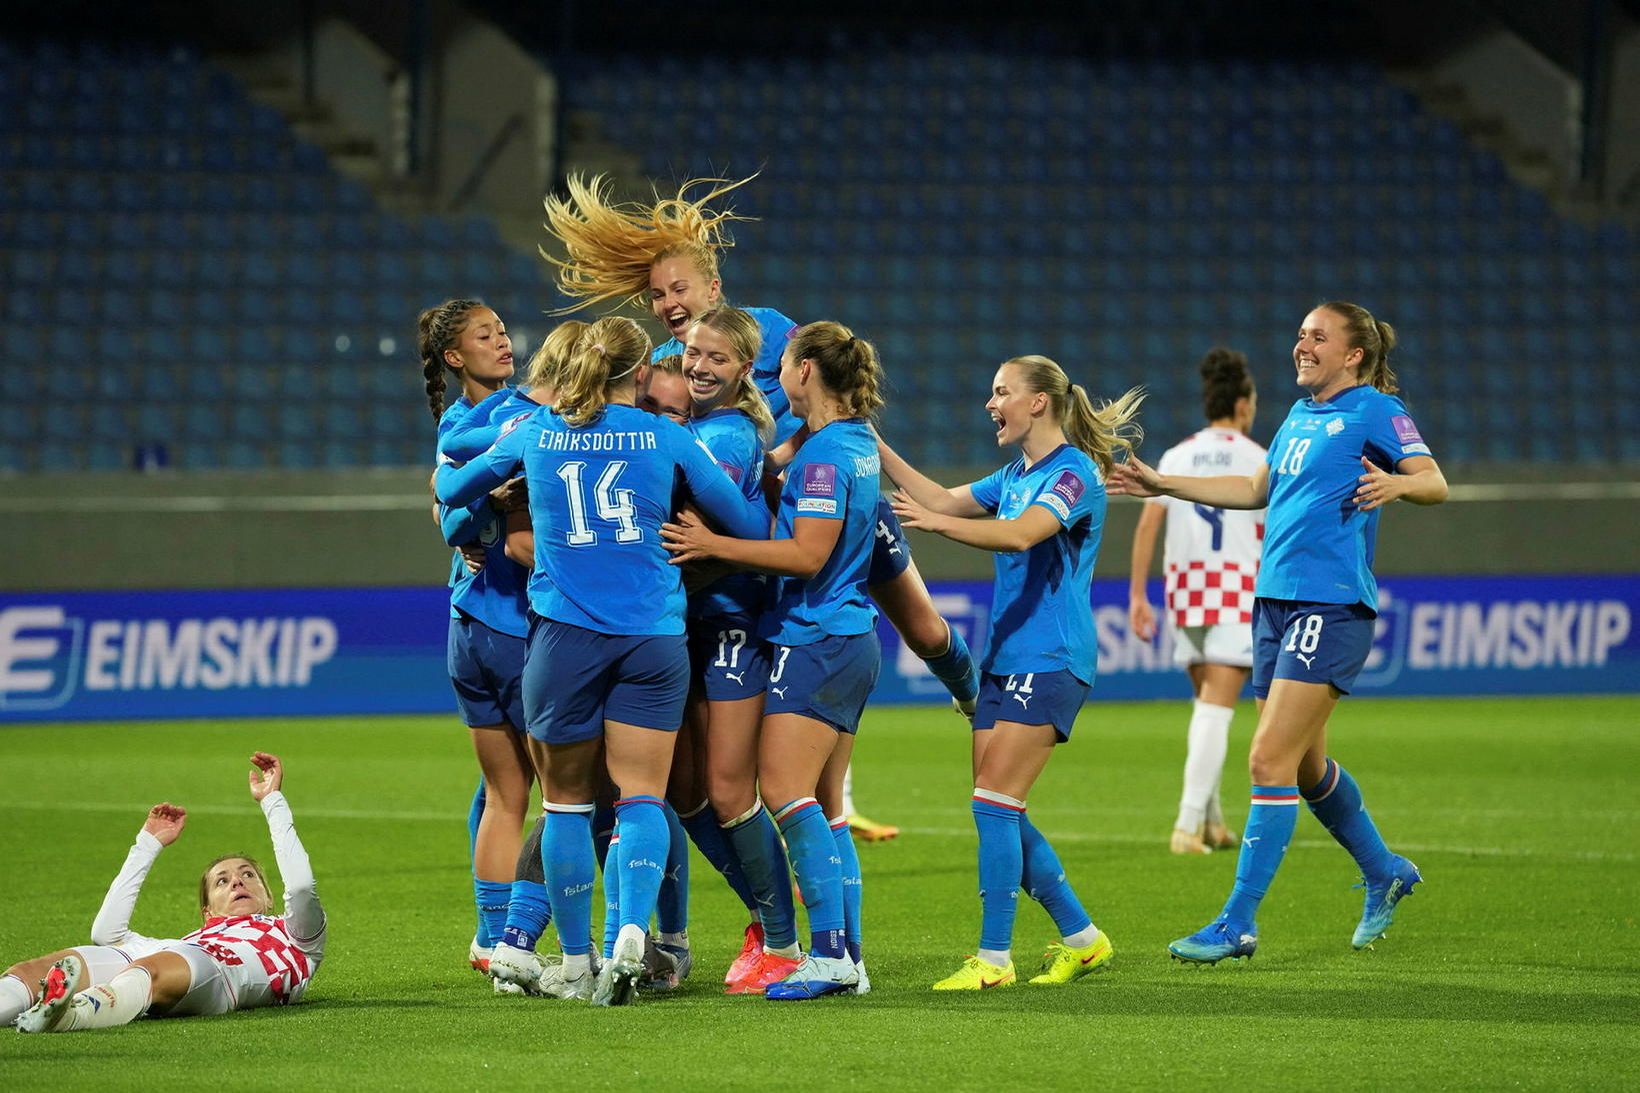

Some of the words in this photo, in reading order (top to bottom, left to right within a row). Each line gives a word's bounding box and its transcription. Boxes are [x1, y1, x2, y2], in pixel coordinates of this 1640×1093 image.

[538, 429, 657, 451] EIRÍKSDÓTTIR
[1277, 437, 1312, 475] 18
[556, 460, 644, 547] 14
[715, 629, 746, 668] 17
[1285, 614, 1323, 653] 18
[1407, 601, 1631, 670] EIMSKIP
[84, 617, 338, 691] EIMSKIP
